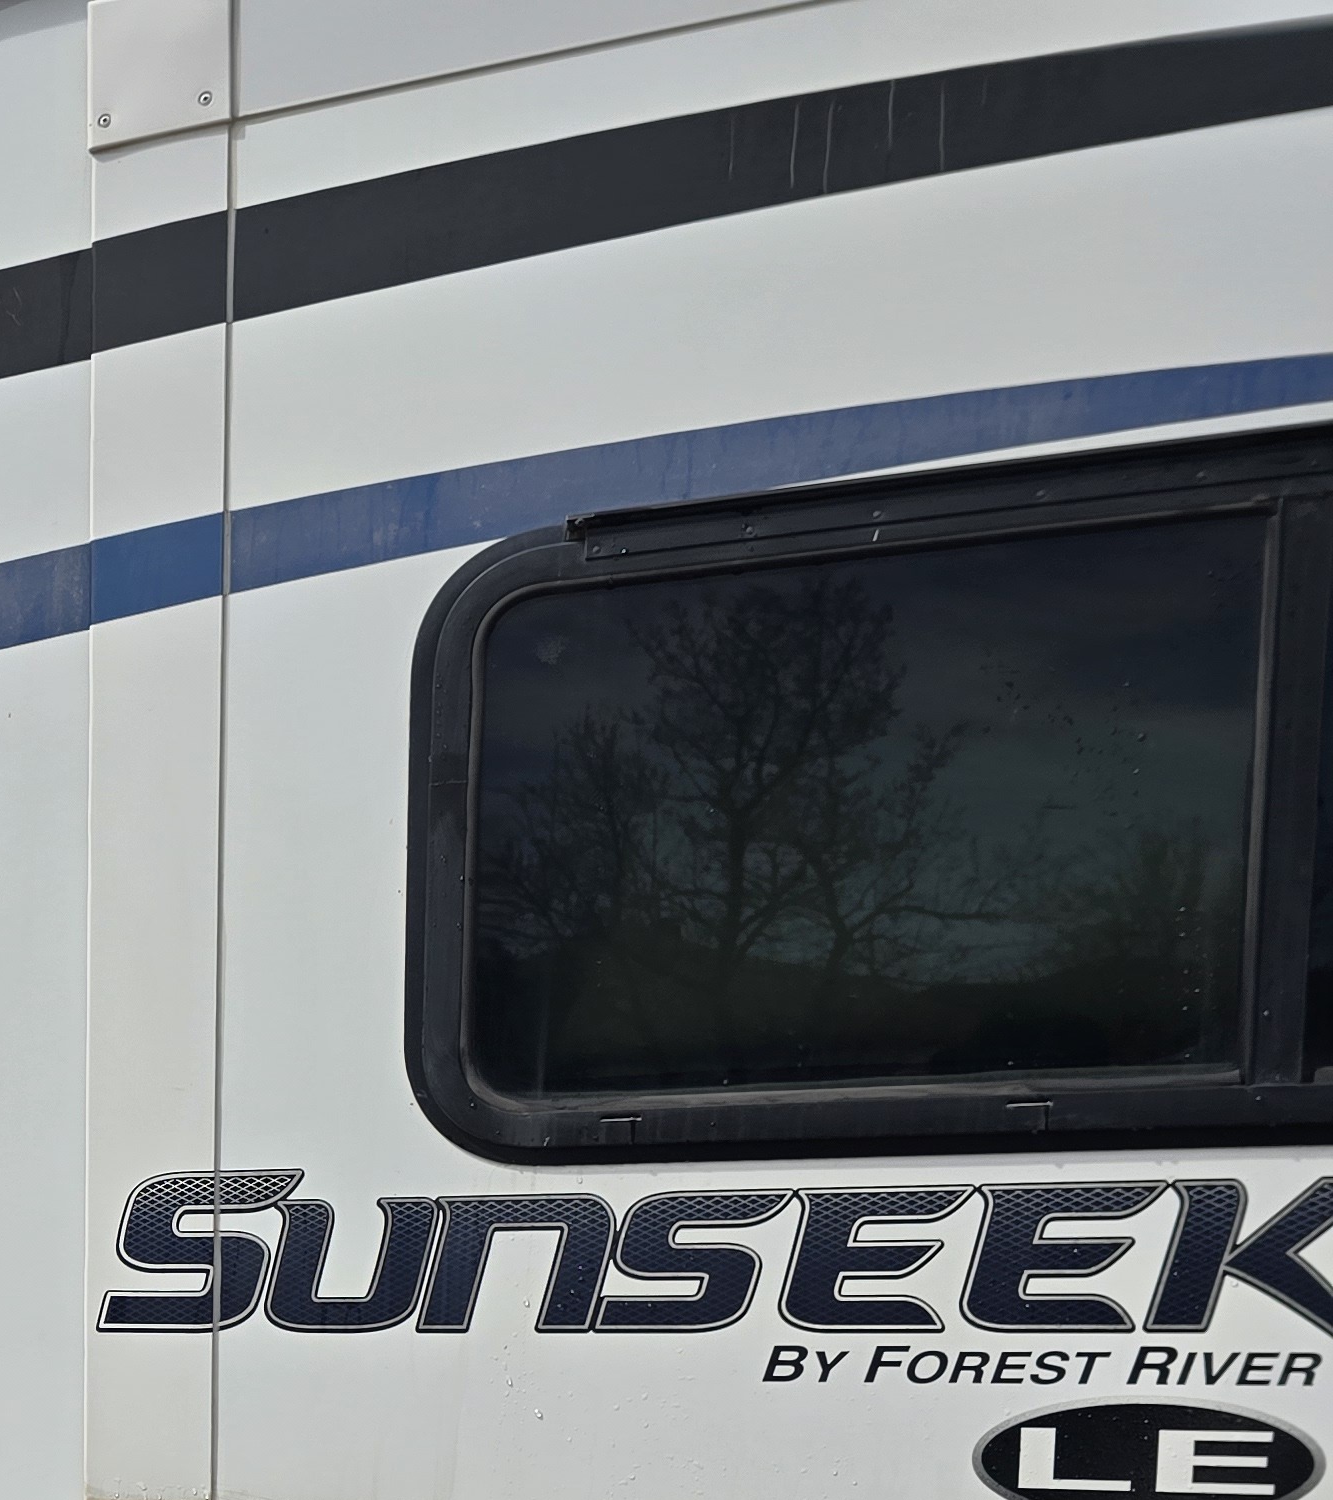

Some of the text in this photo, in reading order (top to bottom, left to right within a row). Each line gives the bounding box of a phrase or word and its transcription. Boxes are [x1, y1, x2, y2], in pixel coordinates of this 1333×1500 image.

[761, 1345, 1323, 1387] BY FOREST RIVER
[1018, 1427, 1276, 1496] LE
